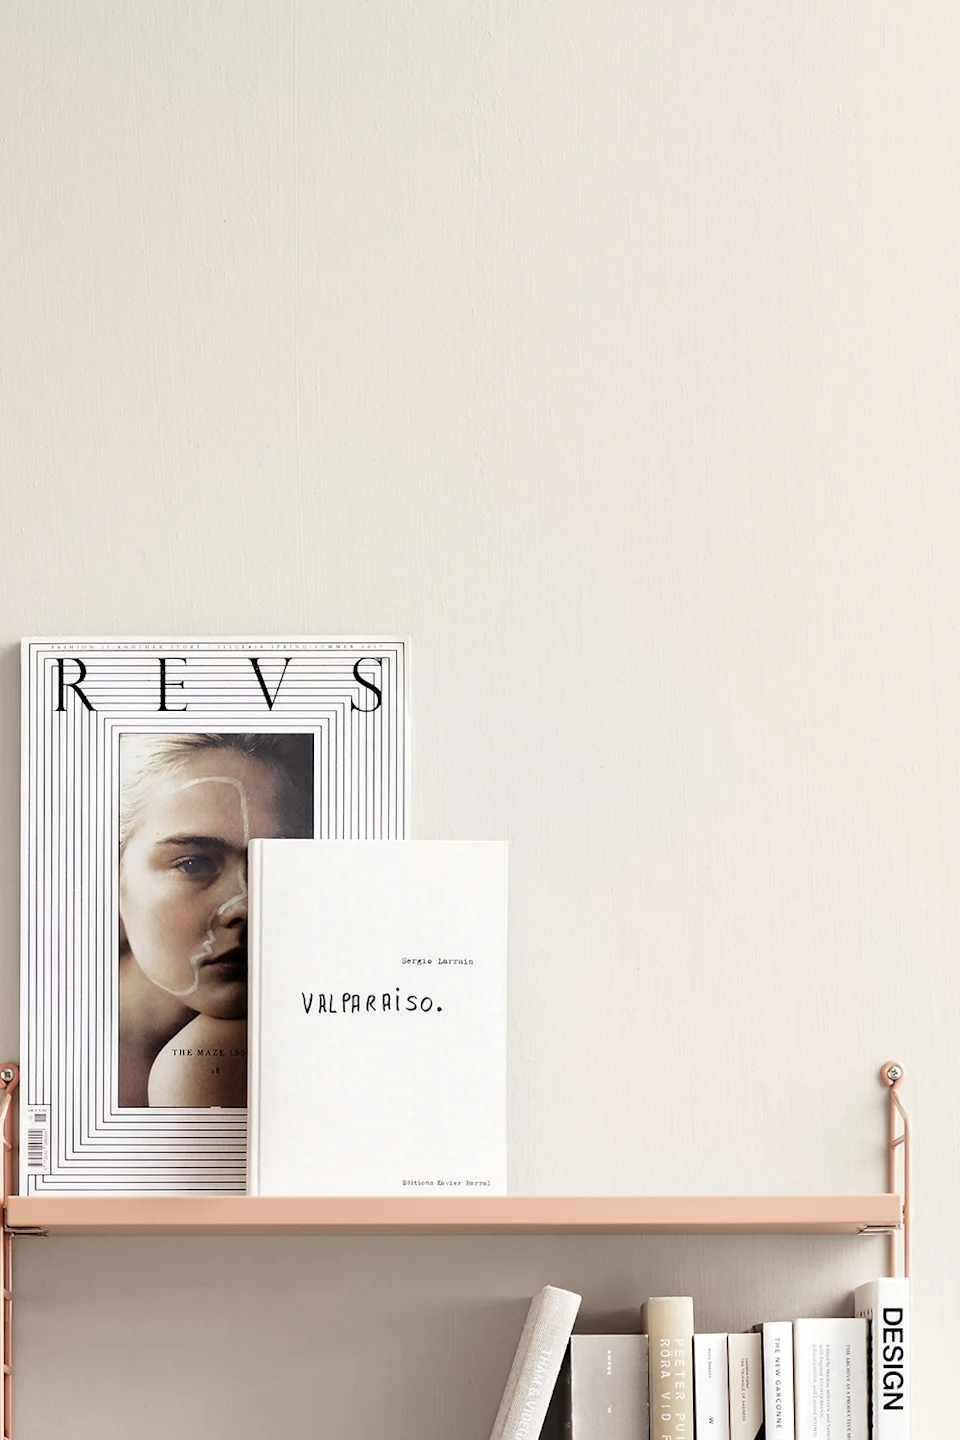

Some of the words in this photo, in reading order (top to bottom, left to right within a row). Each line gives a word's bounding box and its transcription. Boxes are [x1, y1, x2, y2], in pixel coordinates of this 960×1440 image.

[402, 958, 433, 966] Sergio
[531, 1350, 551, 1384] THAM
[660, 1339, 673, 1379] RÖRA
[674, 1339, 686, 1400] PEETER
[883, 1308, 904, 1410] DESIGN
[528, 1387, 540, 1398] &
[661, 1392, 672, 1421] VID
[775, 1380, 783, 1429] GARCONNE
